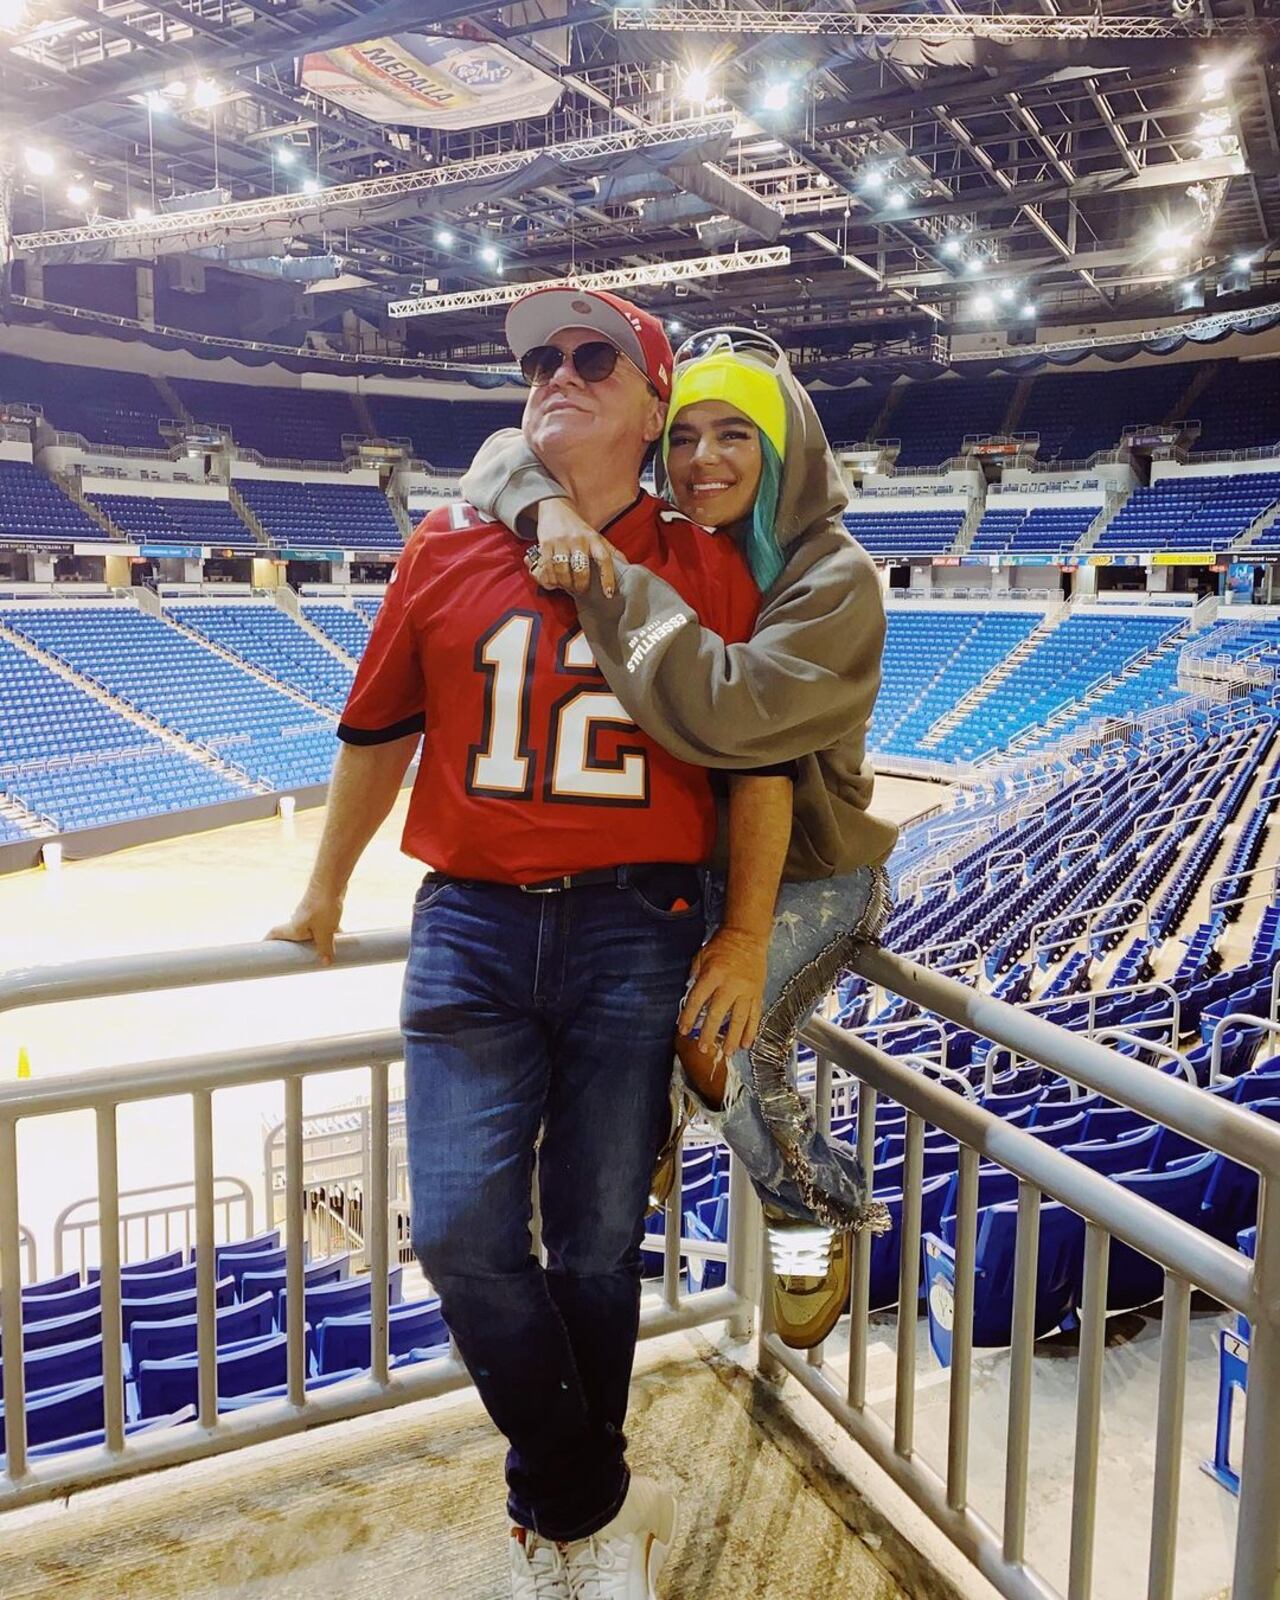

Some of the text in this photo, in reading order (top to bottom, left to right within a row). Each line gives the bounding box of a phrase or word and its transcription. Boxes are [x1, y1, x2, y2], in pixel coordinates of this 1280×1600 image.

[362, 47, 454, 102] MEDALLA
[626, 612, 688, 673] ESSENTIALS
[465, 608, 651, 808] 12
